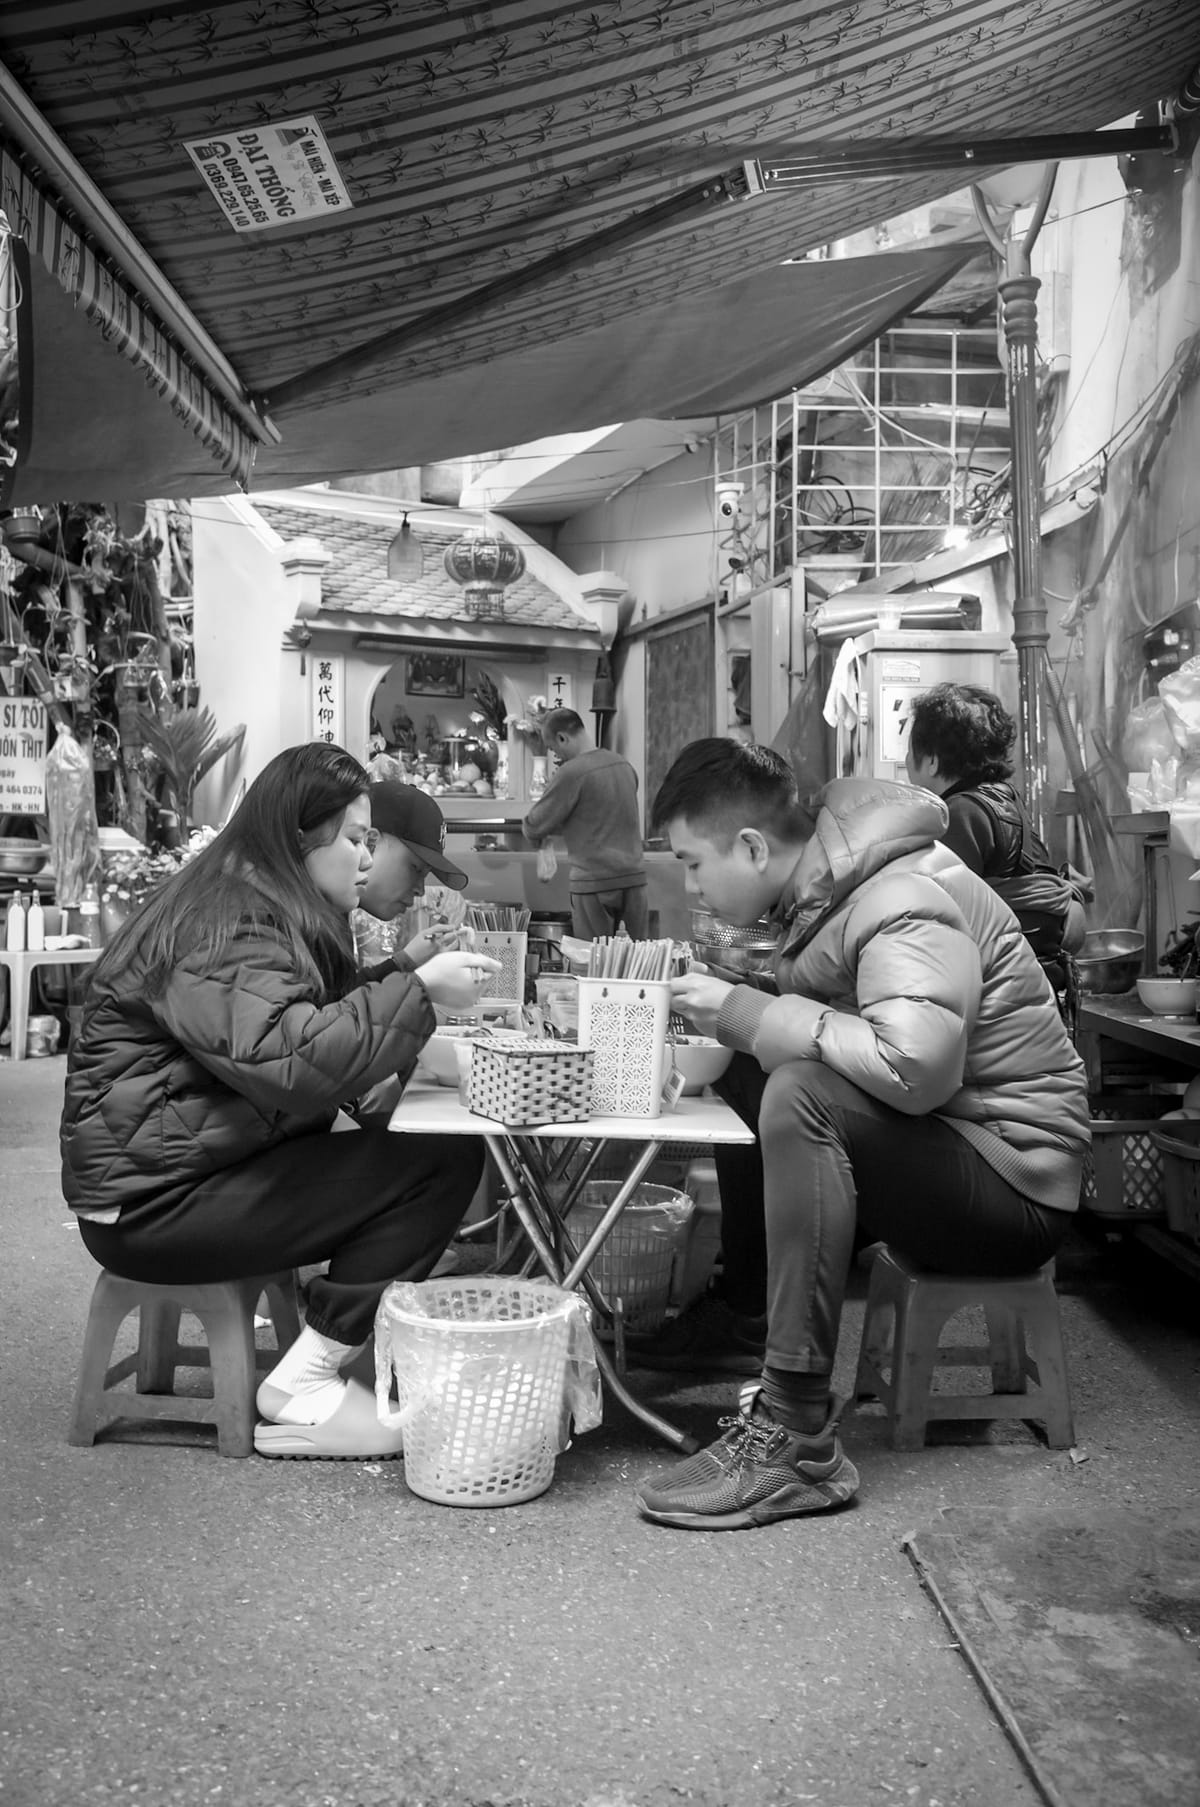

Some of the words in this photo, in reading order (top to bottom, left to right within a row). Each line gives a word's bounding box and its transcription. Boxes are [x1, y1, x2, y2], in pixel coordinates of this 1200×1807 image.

[203, 163, 250, 227] 0369.229.140
[222, 158, 270, 223] 0947.65.25.65
[236, 133, 269, 164] ĐẠI
[255, 164, 297, 218] THỐNG
[299, 139, 320, 157] MÁI
[317, 178, 336, 193] MÁI
[21, 739, 44, 763] THỊT
